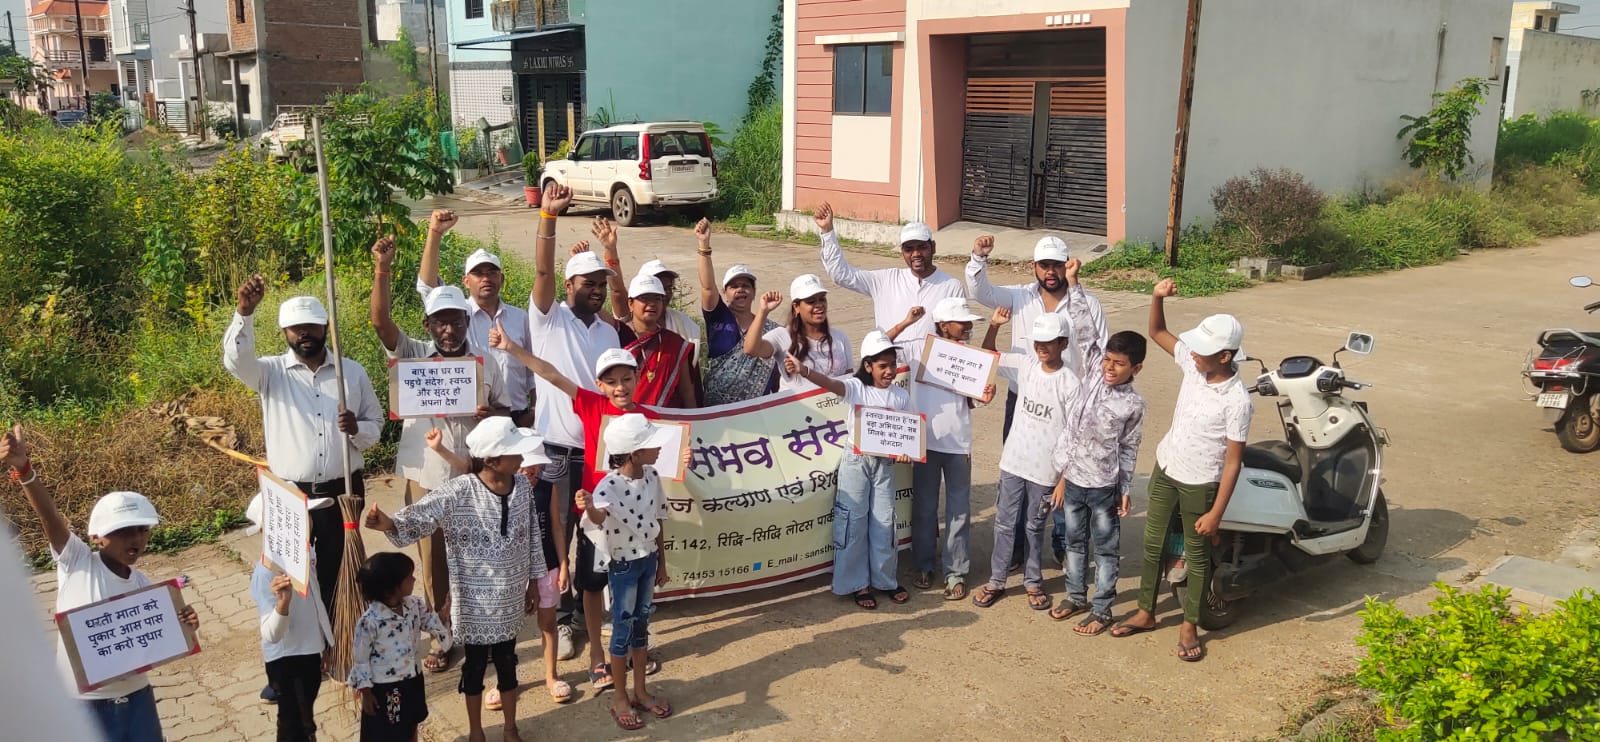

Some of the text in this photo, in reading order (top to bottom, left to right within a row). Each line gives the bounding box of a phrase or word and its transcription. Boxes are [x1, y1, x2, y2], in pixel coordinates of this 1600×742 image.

[530, 56, 548, 69] LAXMI
[411, 368, 426, 377] बापू
[450, 377, 472, 386] स्वच्छ
[417, 387, 430, 396] और
[453, 386, 461, 396] हो
[420, 398, 458, 407] अपना देश
[880, 438, 903, 448] योगदान
[688, 437, 773, 480] संभव
[702, 489, 772, 512] कल्याण
[775, 476, 803, 504] एवं
[786, 520, 814, 536] लोटस
[683, 570, 715, 581] 74153
[719, 565, 750, 577] 15166
[768, 553, 798, 568] E_mail
[85, 598, 160, 628] धरती माता करे
[88, 613, 164, 648] पुकार आस पास
[97, 629, 163, 657] का करो सुधार
